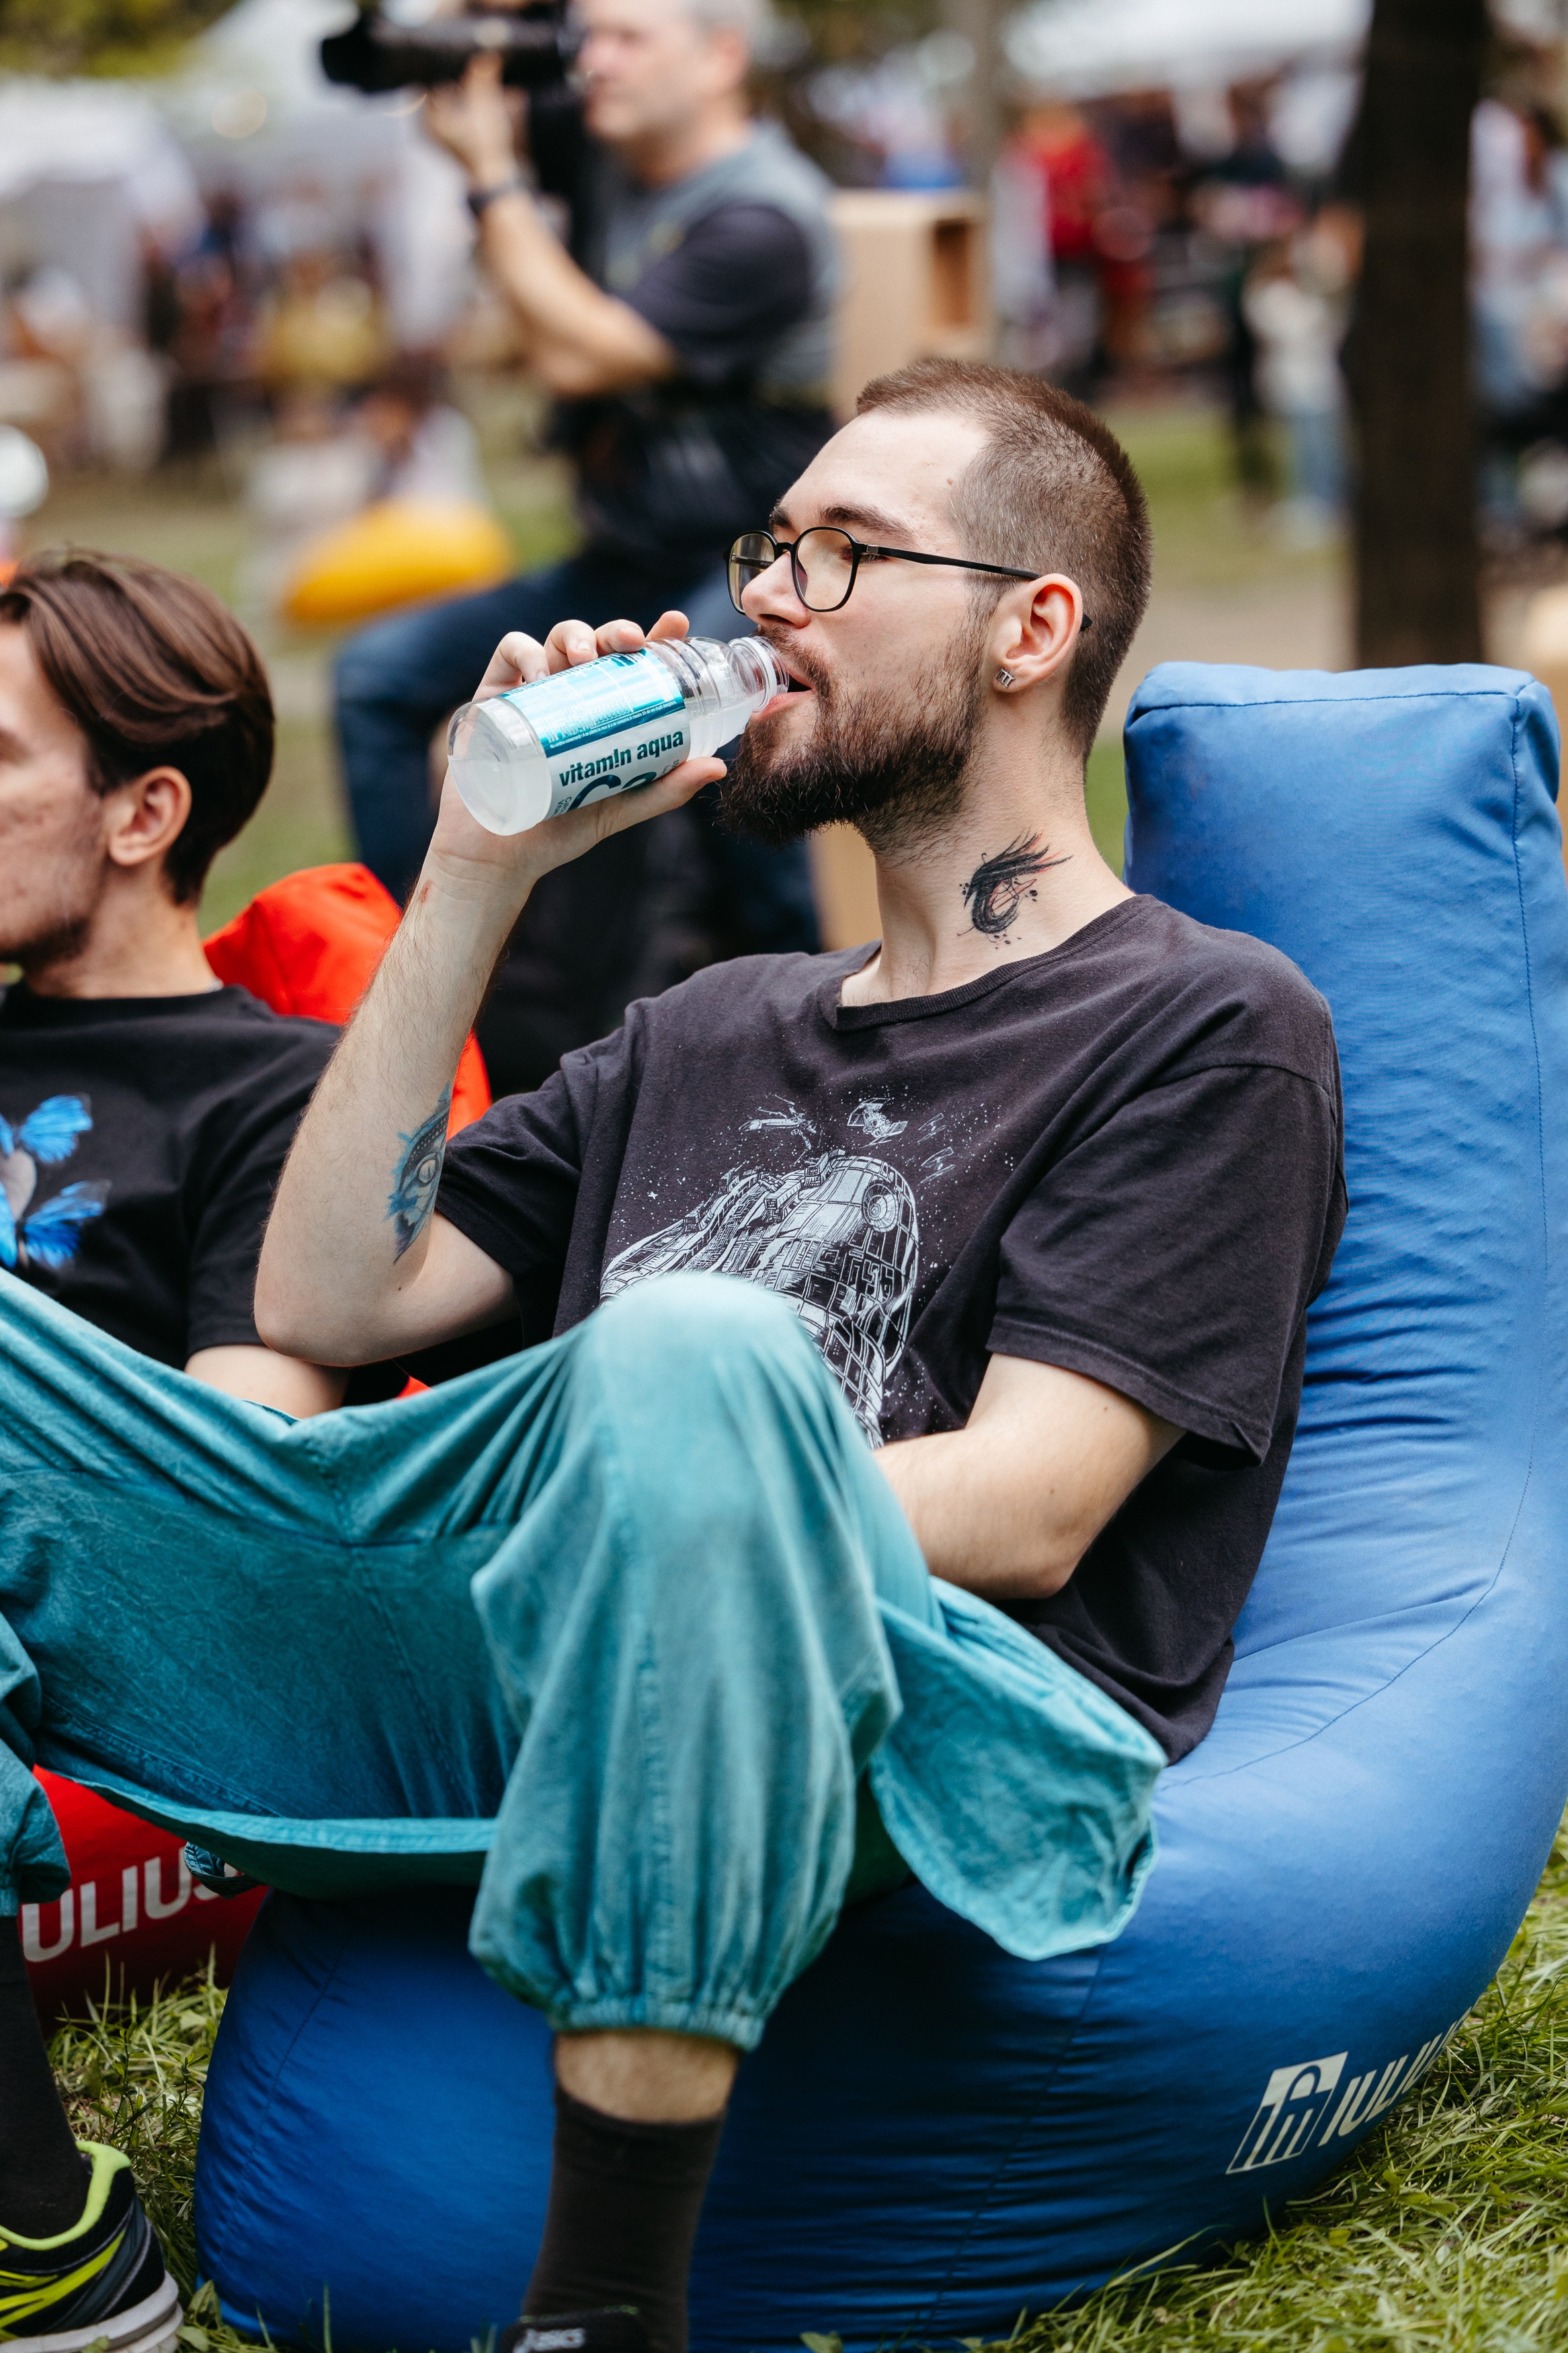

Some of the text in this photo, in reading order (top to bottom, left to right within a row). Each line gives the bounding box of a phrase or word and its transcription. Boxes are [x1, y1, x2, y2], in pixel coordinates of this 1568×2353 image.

[559, 748, 632, 787] vitam!n
[636, 731, 684, 760] aqua
[22, 1846, 238, 1962] ULIU
[1317, 2005, 1472, 2147] IULIU
